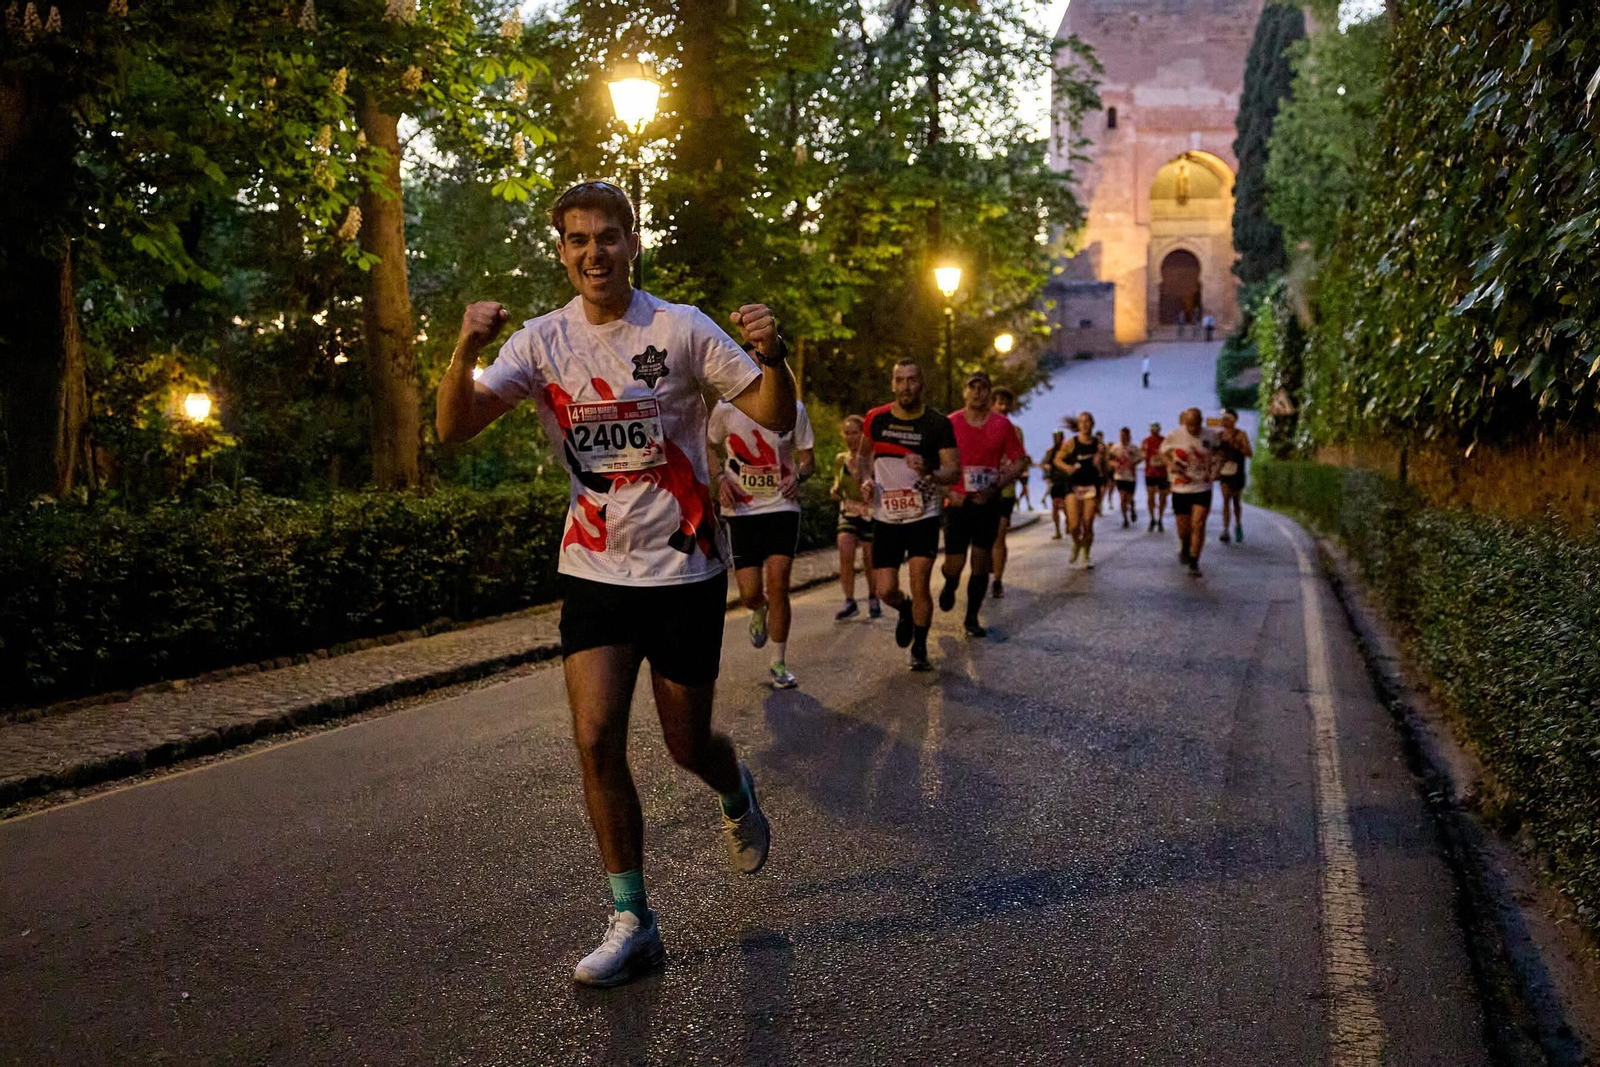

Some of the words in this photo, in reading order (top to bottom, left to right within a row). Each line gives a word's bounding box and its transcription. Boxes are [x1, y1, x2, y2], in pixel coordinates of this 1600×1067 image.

[572, 406, 585, 422] 41
[574, 422, 647, 452] 2406
[741, 474, 775, 487] 1038
[884, 497, 916, 511] 1984
